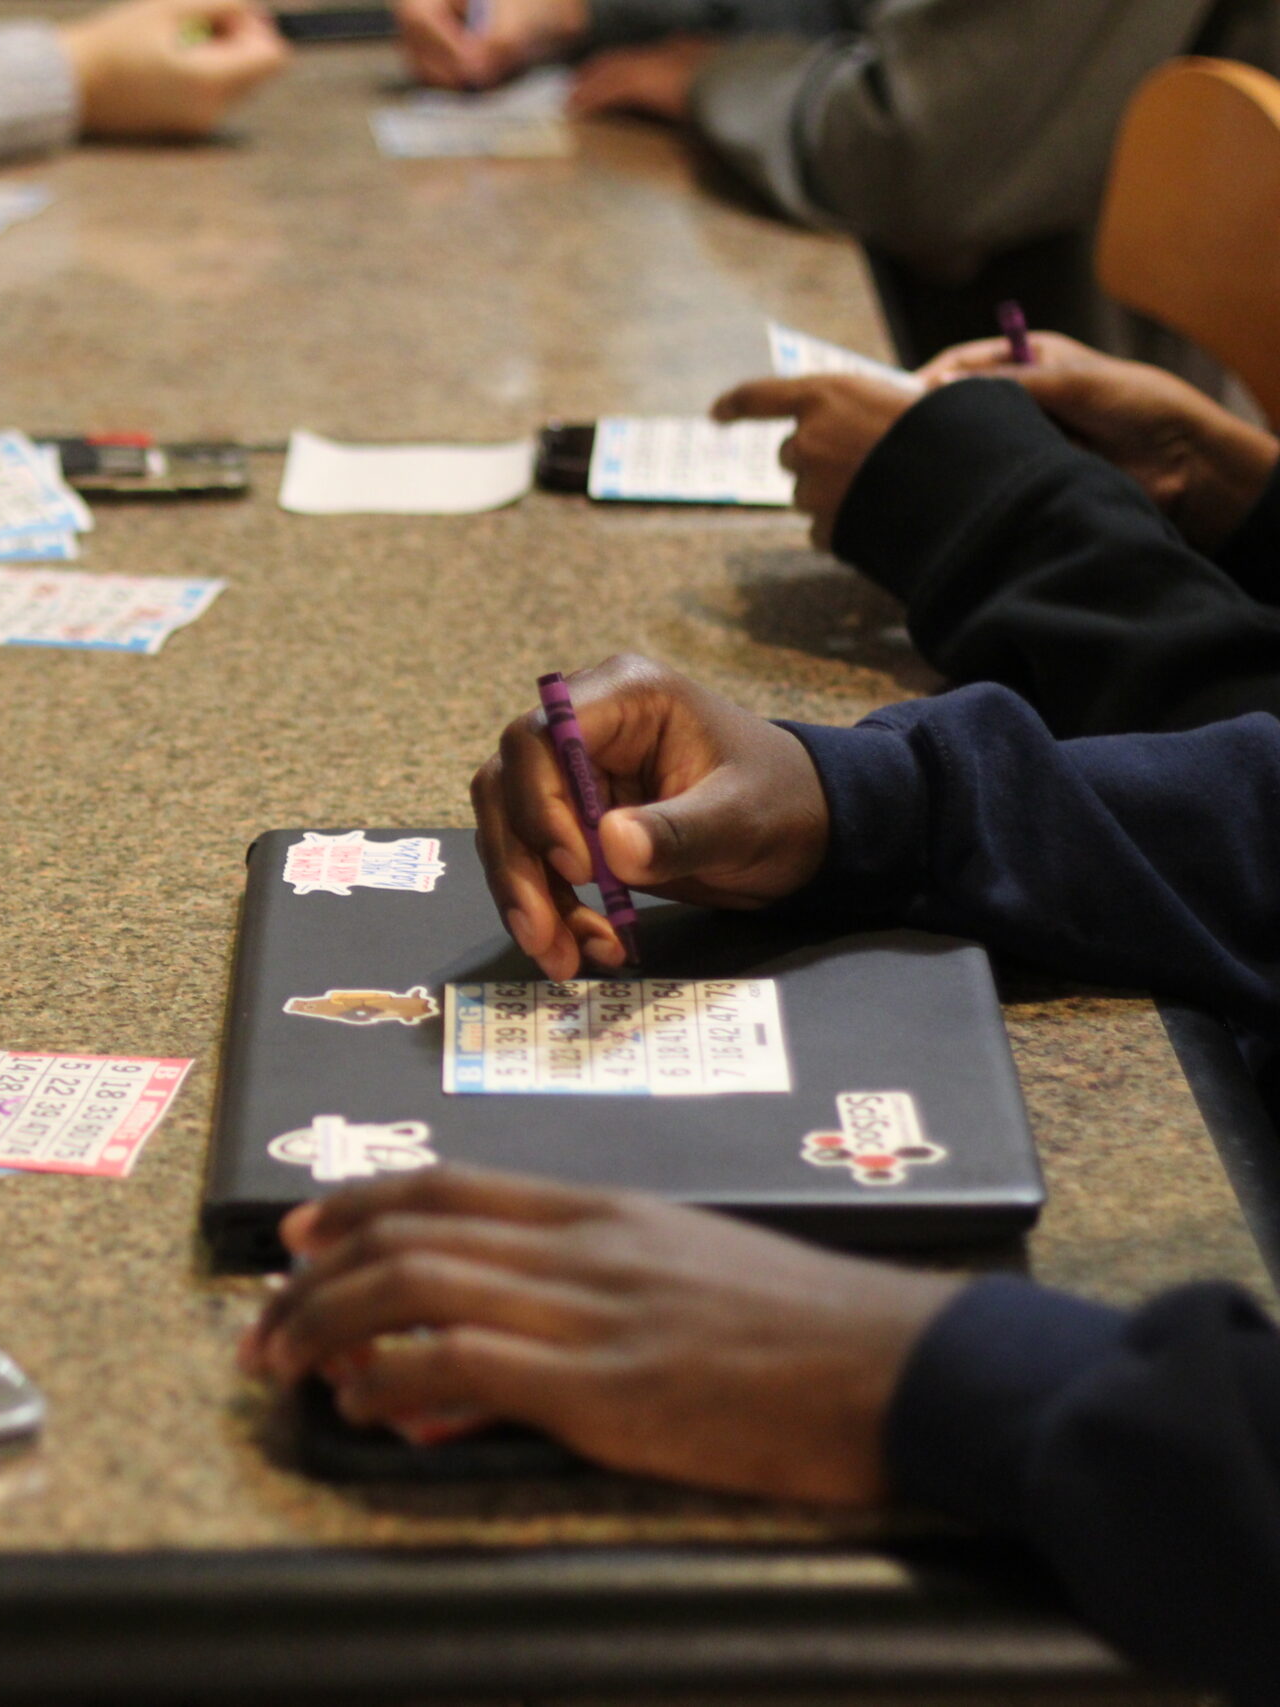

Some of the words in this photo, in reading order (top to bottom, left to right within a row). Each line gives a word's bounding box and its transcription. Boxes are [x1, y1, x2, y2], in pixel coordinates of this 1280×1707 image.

[495, 981, 527, 996] 62
[599, 983, 631, 997] 65
[651, 982, 684, 998] 64
[704, 983, 736, 997] 73
[495, 1002, 527, 1020] 53
[600, 1003, 632, 1021] 54
[653, 1003, 686, 1021] 57
[705, 1003, 740, 1021] 47
[495, 1027, 527, 1044] 39
[548, 1027, 580, 1044] 43
[654, 1028, 688, 1042] 41
[709, 1027, 741, 1042] 42
[6, 1056, 43, 1071] 14
[111, 1064, 142, 1073] 9
[549, 1063, 581, 1079] 11
[658, 1068, 691, 1076] 6
[713, 1068, 746, 1076] 7
[42, 1076, 80, 1096] 22
[95, 1081, 131, 1099] 18
[29, 1101, 67, 1117] 39
[81, 1103, 118, 1120] 33
[18, 1121, 50, 1136] 47
[0, 1137, 39, 1154] 74
[53, 1141, 91, 1158] 75
